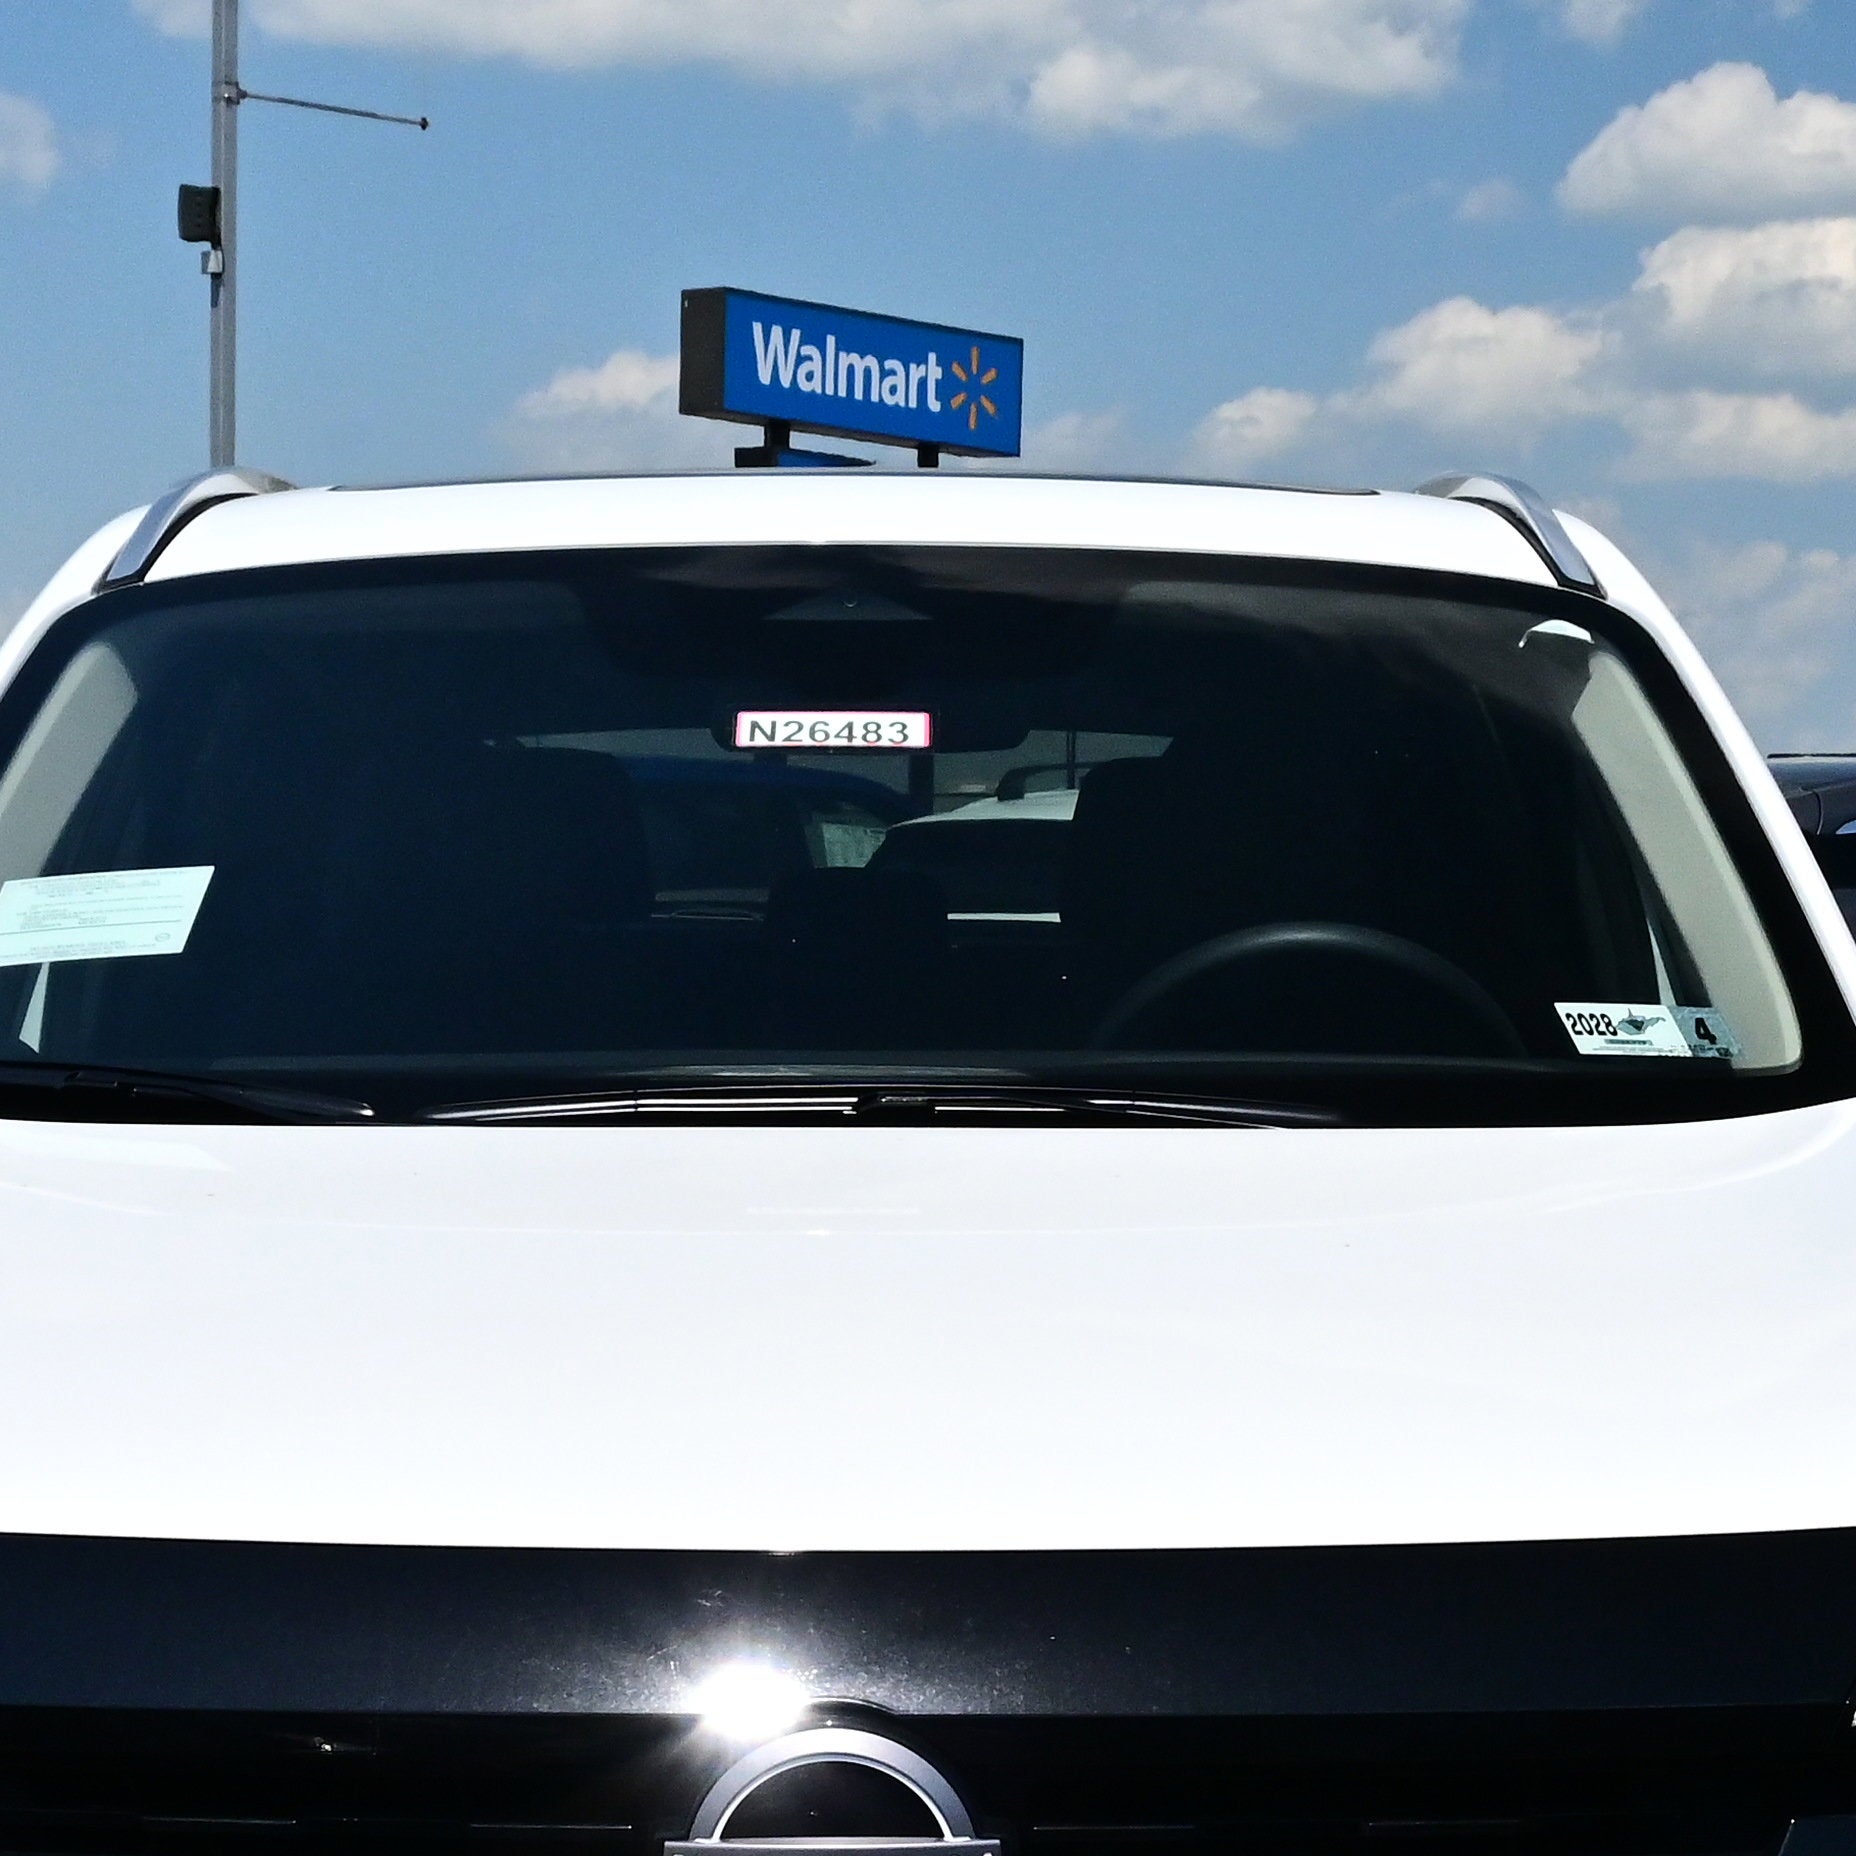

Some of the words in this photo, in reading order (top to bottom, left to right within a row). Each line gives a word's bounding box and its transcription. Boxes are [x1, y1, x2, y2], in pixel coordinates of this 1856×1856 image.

[752, 320, 943, 413] Walmart
[749, 720, 910, 744] N26483
[1565, 1012, 1618, 1037] 2028
[1694, 1017, 1718, 1046] 4
